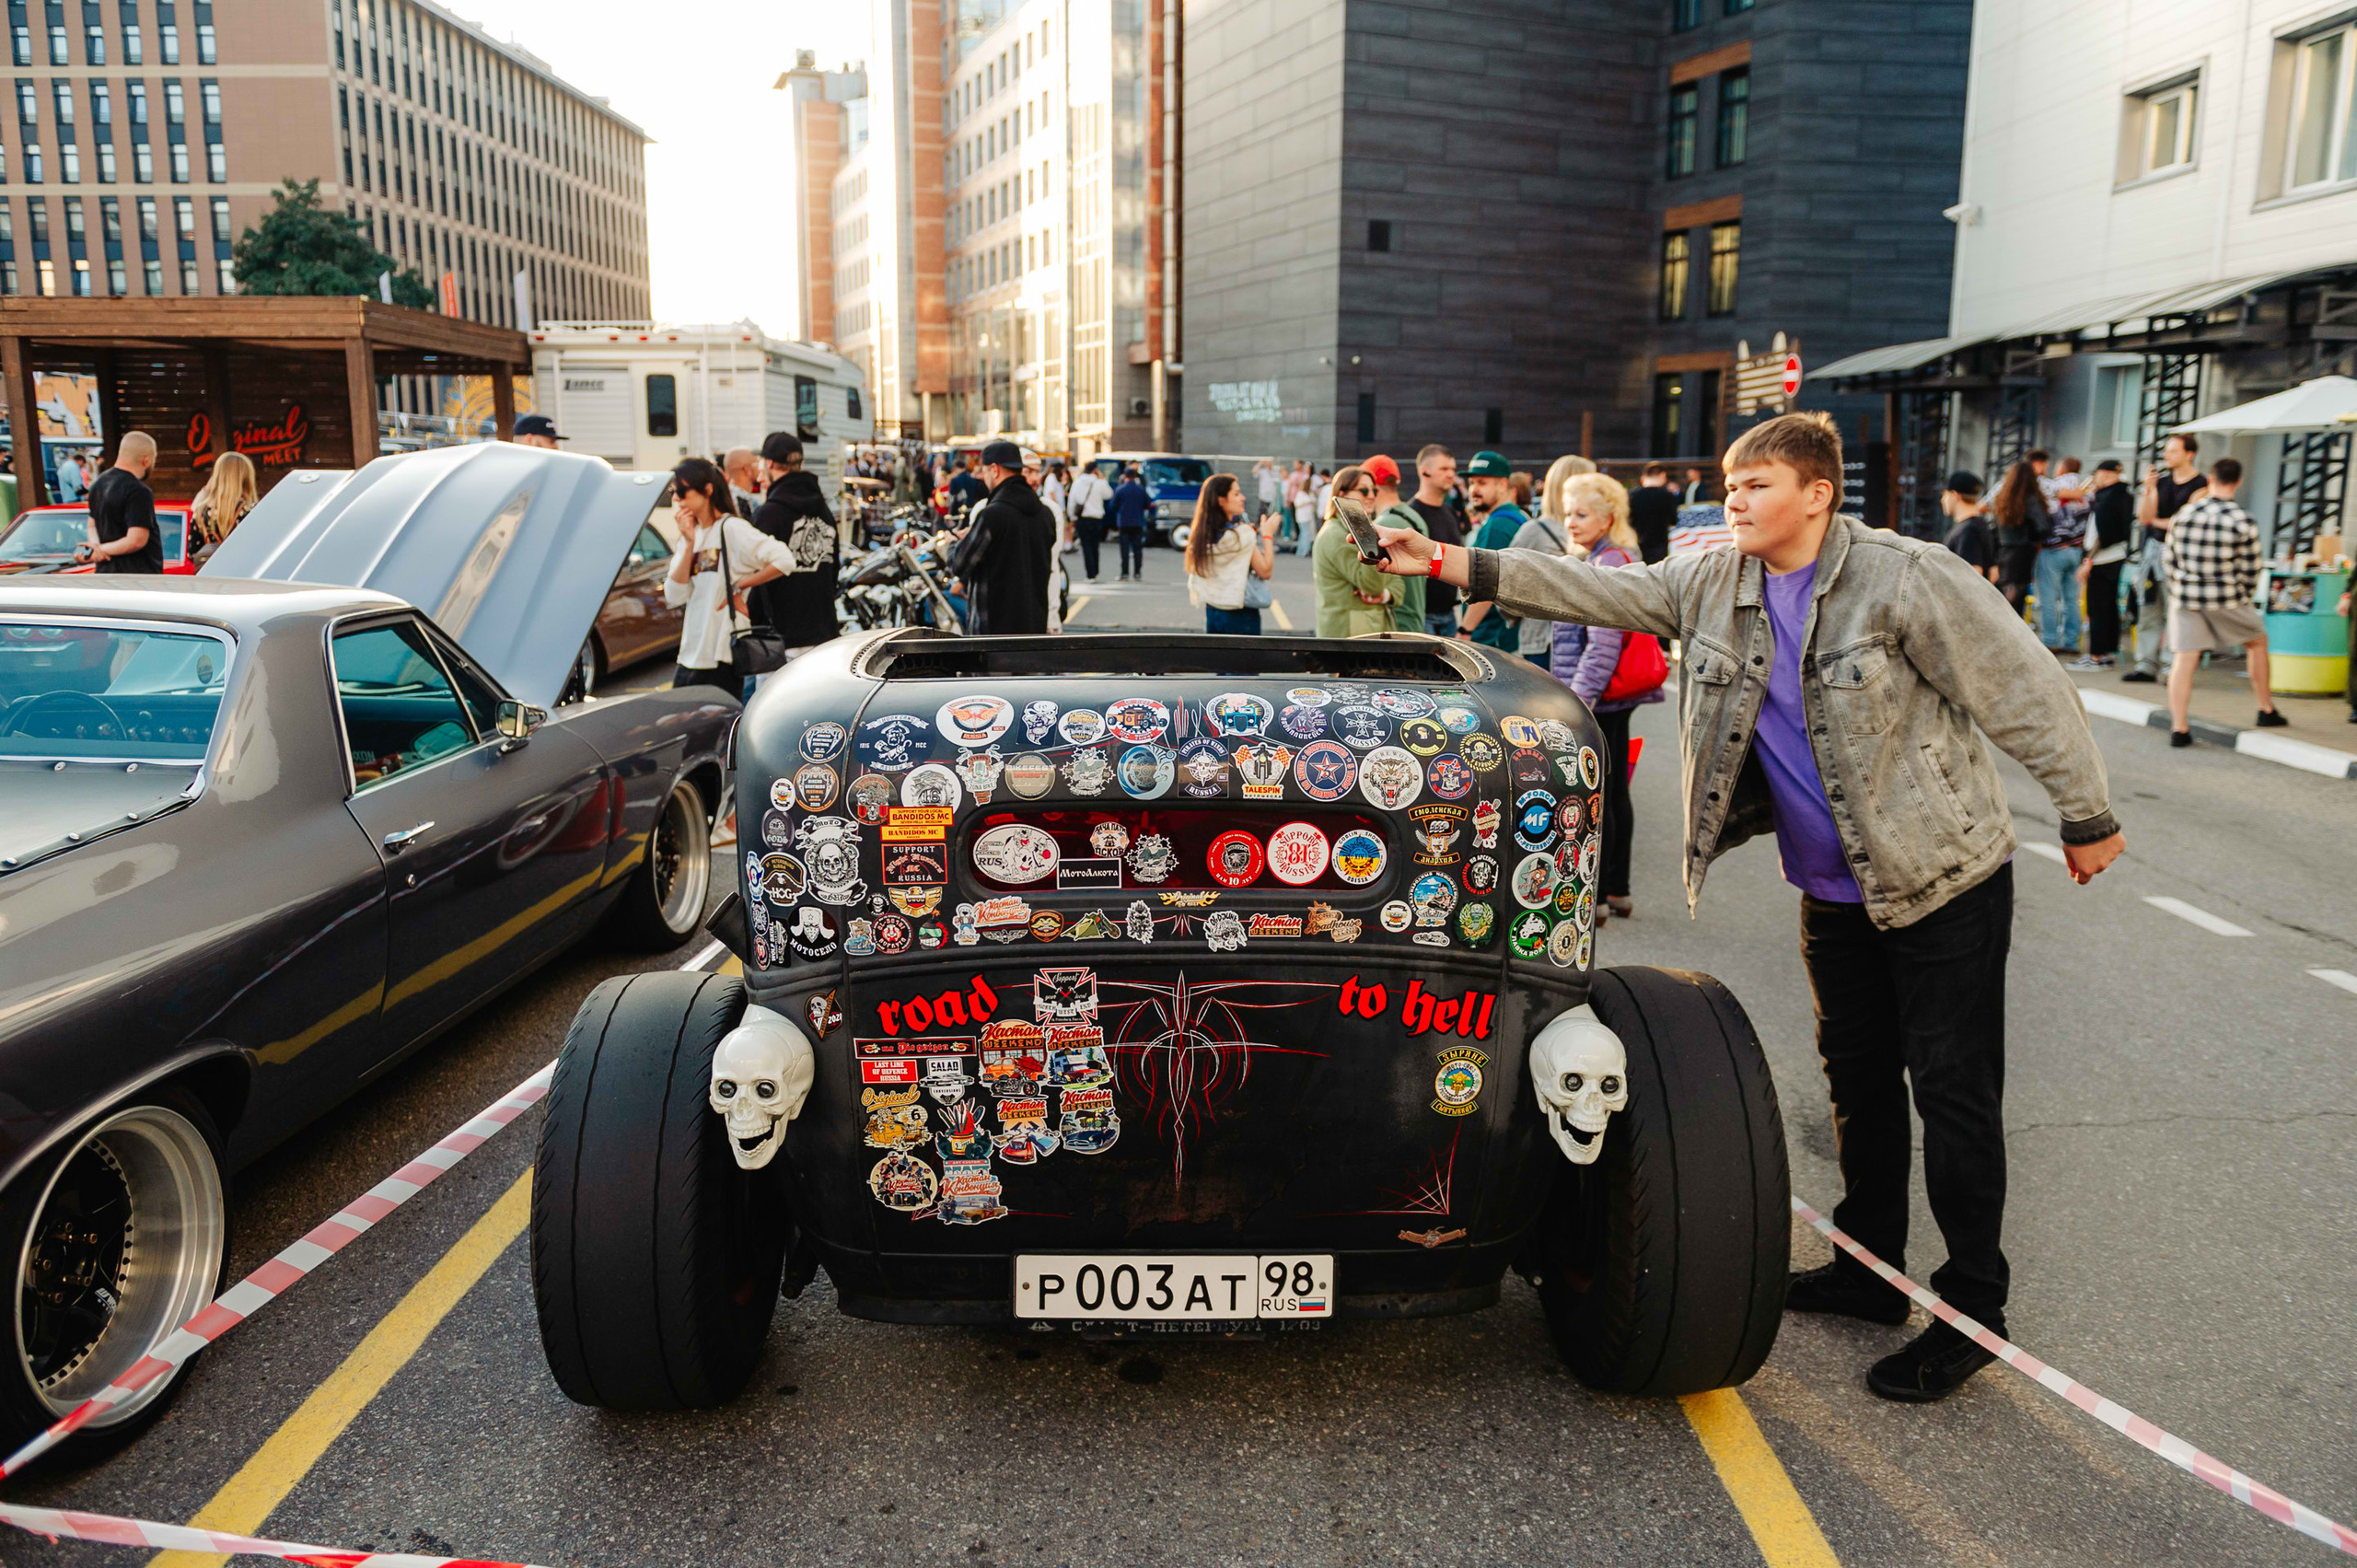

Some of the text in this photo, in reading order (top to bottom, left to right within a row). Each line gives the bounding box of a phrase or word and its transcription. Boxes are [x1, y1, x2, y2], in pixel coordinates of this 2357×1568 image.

[187, 405, 308, 457] Oginal
[262, 447, 301, 466] MEET
[1347, 738, 1379, 746] RUSSIA
[1189, 787, 1218, 796] RUSSIA
[1365, 786, 1380, 801] SAINT
[1519, 791, 1555, 805] M-FORCE
[1415, 807, 1462, 817] СМОЛЕНСКАЯ
[1524, 812, 1553, 826] MF
[1279, 831, 1320, 848] SUPPORT
[1365, 831, 1381, 845] SHOW
[1096, 848, 1124, 857] ПСКОВ
[1289, 842, 1308, 865] 81
[978, 858, 1003, 866] RUS
[1421, 857, 1453, 865] АНАРХИЯ
[1280, 862, 1316, 877] RUSSIA
[772, 888, 792, 899] HOG
[1250, 927, 1299, 935] WEEKEND
[1305, 918, 1361, 934] Roadhouse
[790, 939, 838, 957] МОТОСЕЛО
[1052, 973, 1079, 983] Support
[877, 974, 998, 1035] road
[1339, 974, 1496, 1040] to hell
[828, 1012, 842, 1025] 2021
[983, 1039, 1042, 1048] WEEKEND
[1048, 1038, 1101, 1050] WEEKEND
[1442, 1049, 1484, 1064] ЗЫРЯНЕ
[931, 1061, 959, 1072] SALAD
[862, 1084, 920, 1105] Original
[1062, 1101, 1111, 1111] WEEKEND
[1435, 1103, 1473, 1115] СЫКТЫВКАР
[911, 1109, 921, 1120] 6
[1000, 1111, 1045, 1120] WEEKEND
[1265, 1261, 1314, 1297] 98
[1262, 1299, 1297, 1311] RUS
